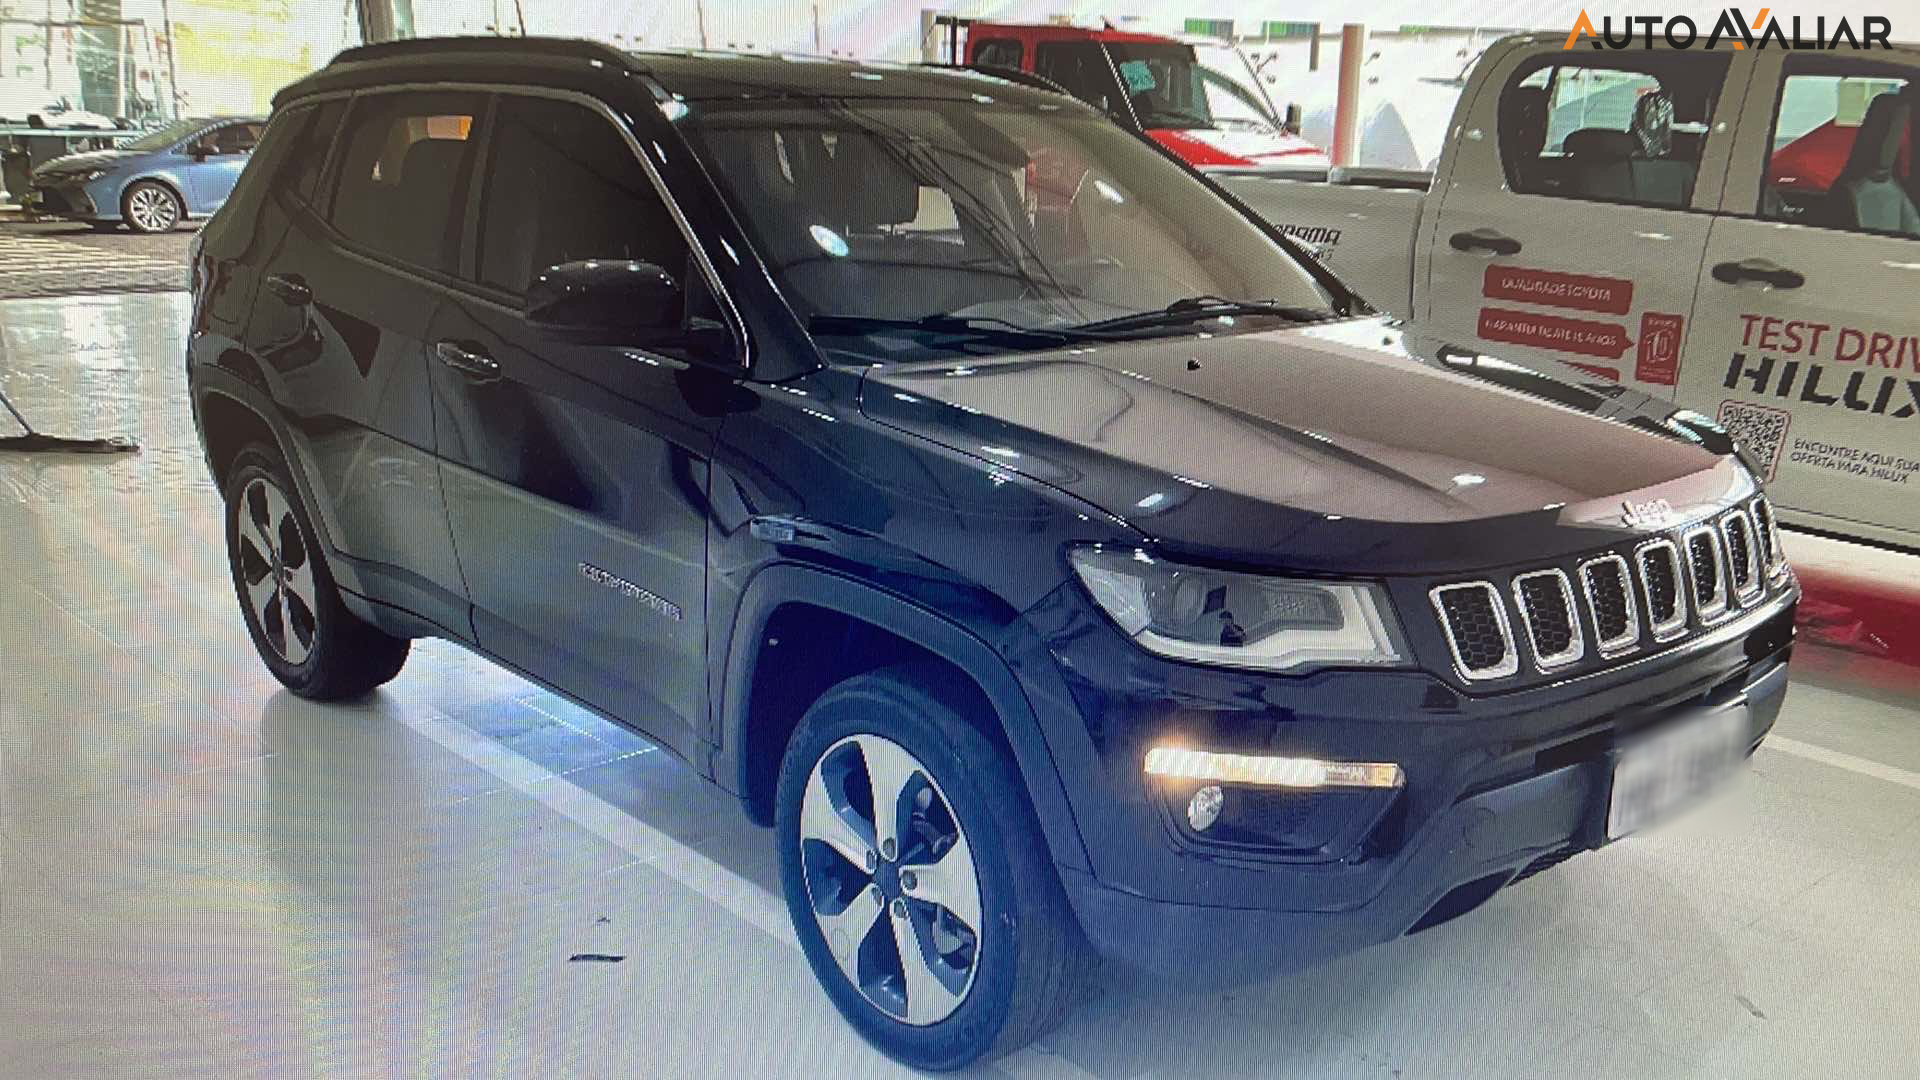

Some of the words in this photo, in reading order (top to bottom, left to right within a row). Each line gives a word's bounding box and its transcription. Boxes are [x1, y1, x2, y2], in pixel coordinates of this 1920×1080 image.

[1740, 314, 1830, 356] TEST
[1723, 352, 1920, 418] HILUX
[1791, 451, 1836, 469] OFERTA
[1870, 467, 1910, 484] HILUX
[1794, 438, 1860, 461] ENCONTRE
[1861, 451, 1893, 467] AQUI
